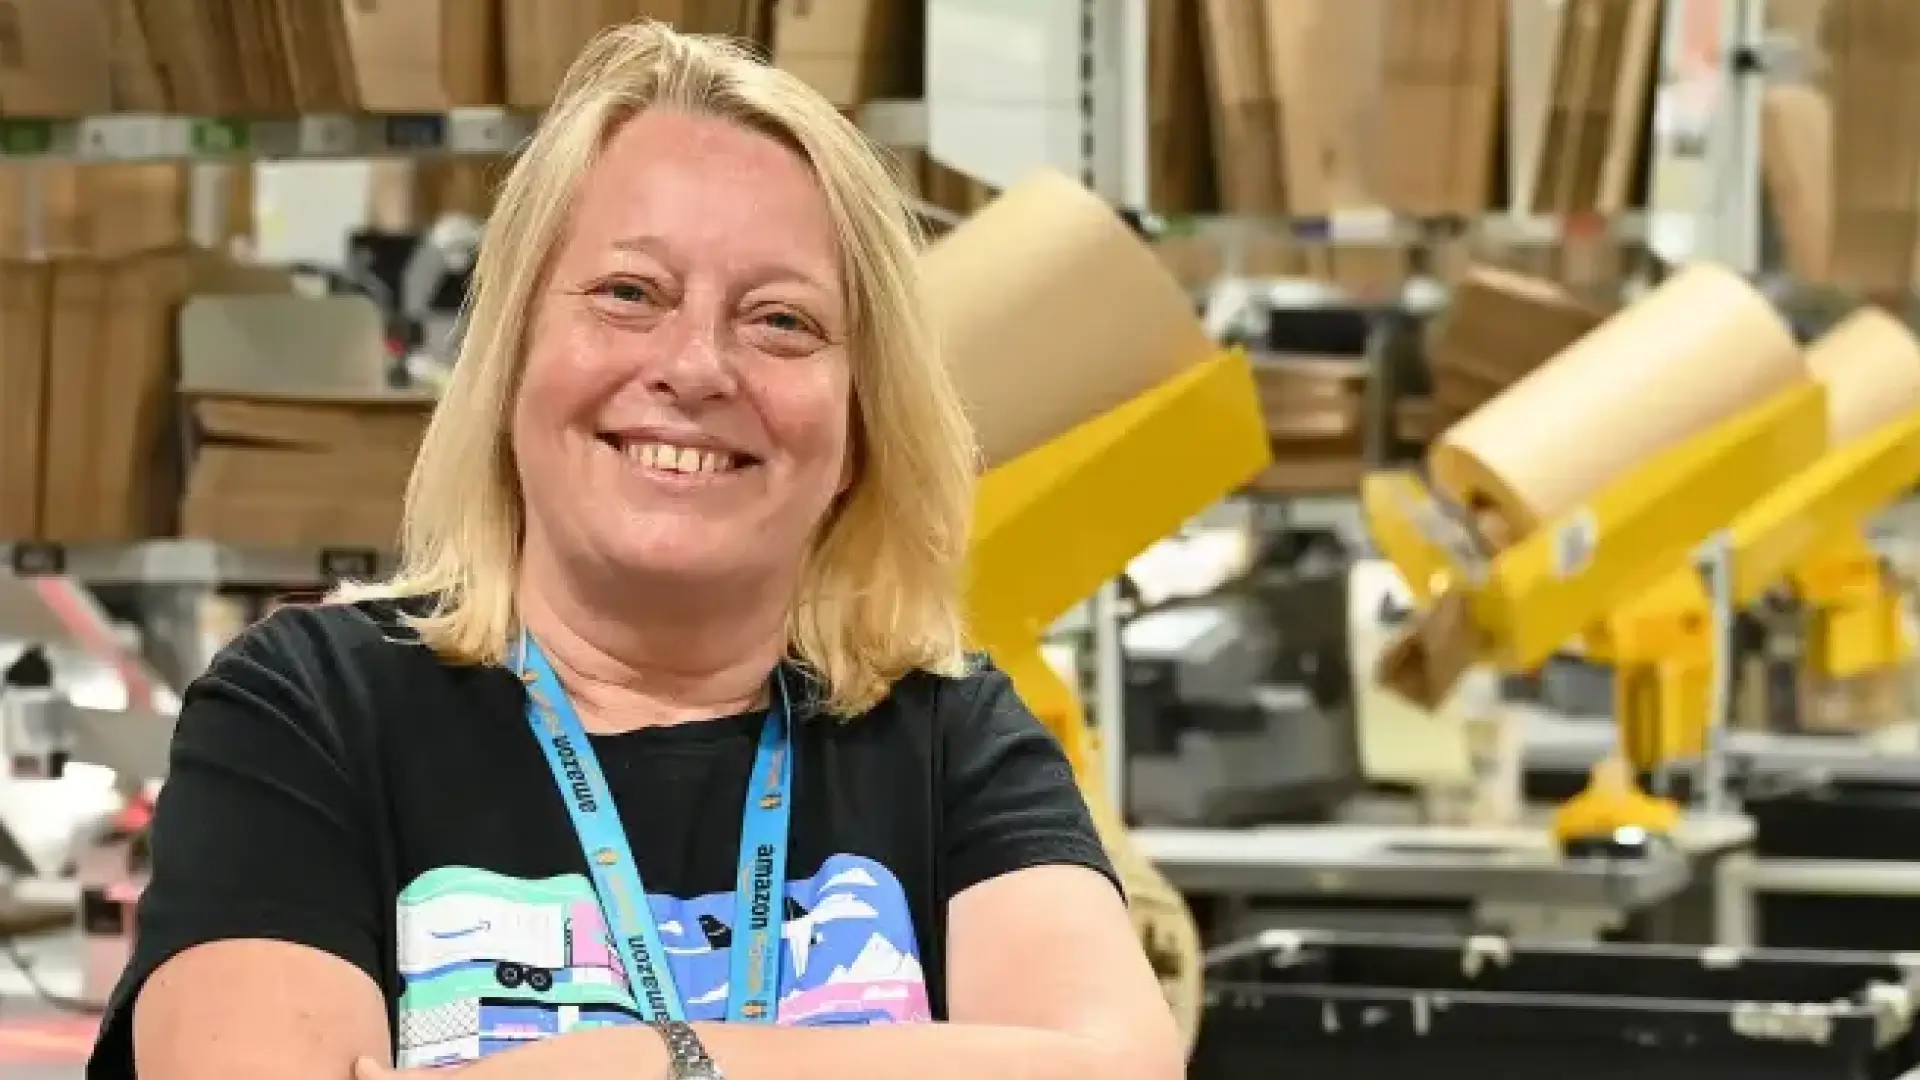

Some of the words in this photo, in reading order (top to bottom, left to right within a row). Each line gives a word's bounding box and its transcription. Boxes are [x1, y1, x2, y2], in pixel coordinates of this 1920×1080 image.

[552, 735, 597, 813] amazon
[750, 844, 774, 930] amazon
[628, 935, 671, 1023] amazon
